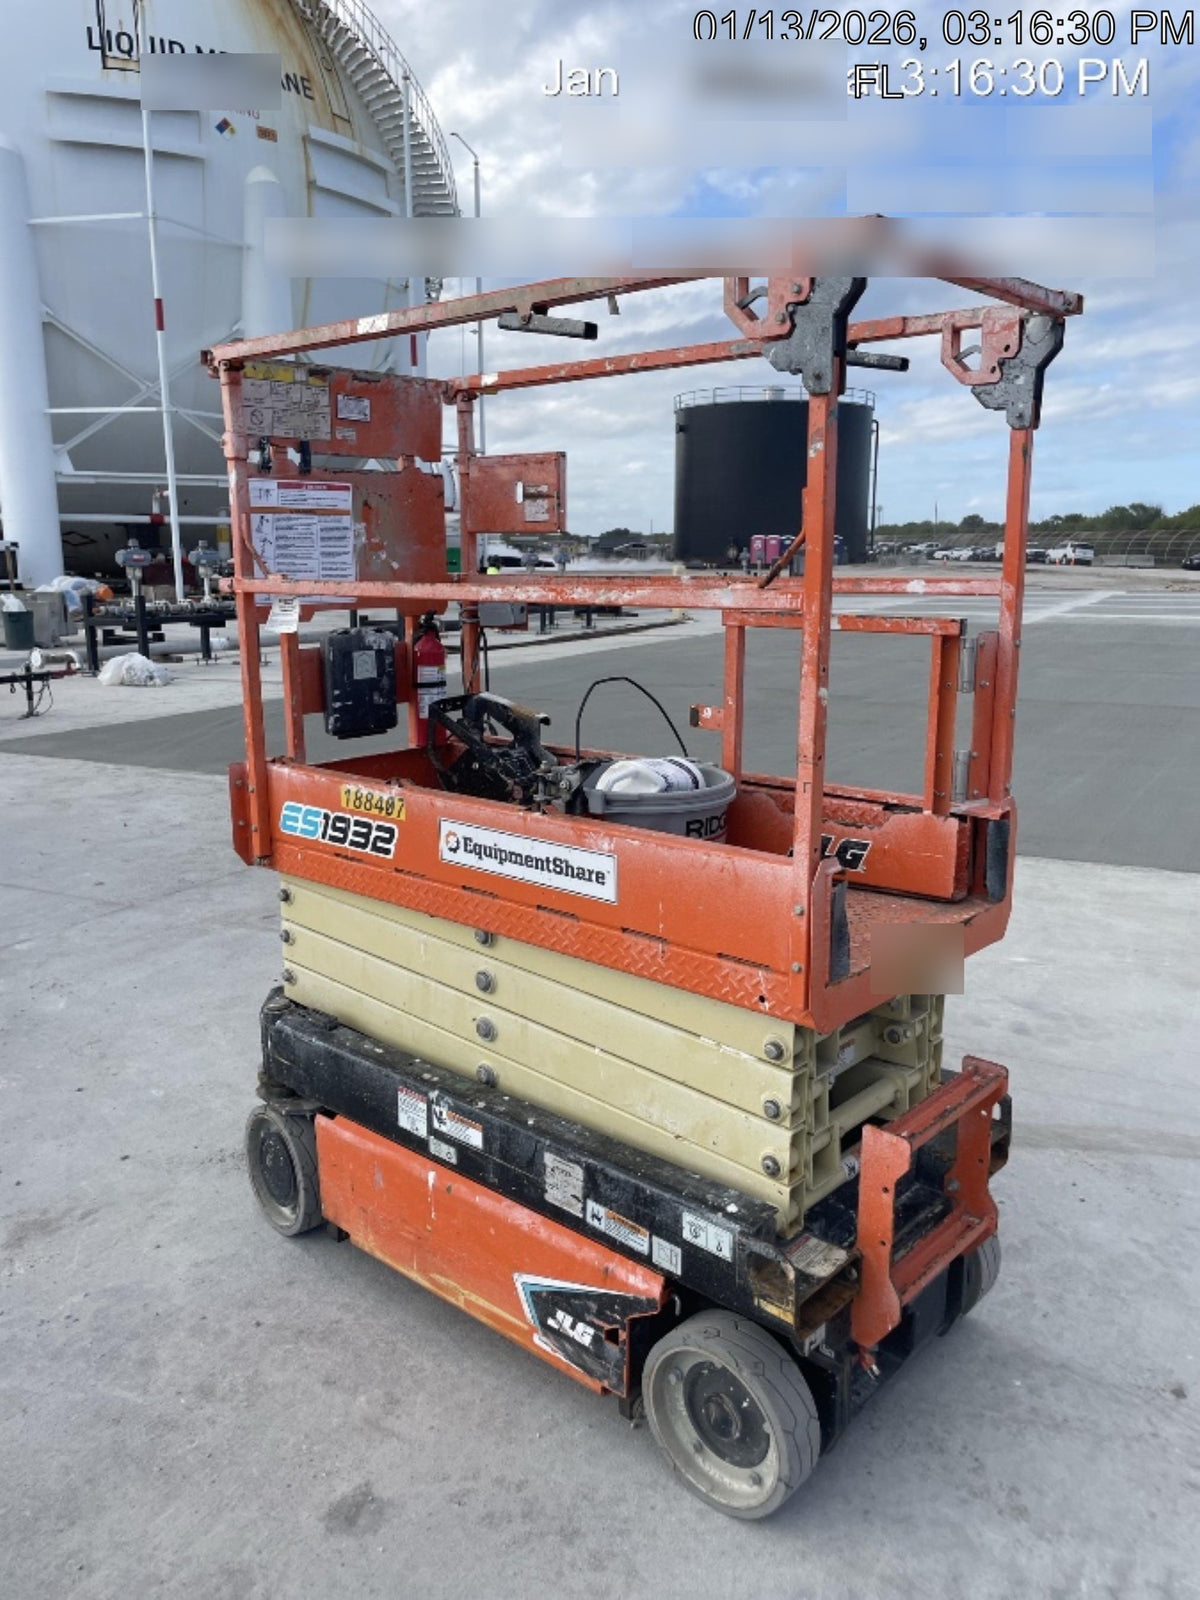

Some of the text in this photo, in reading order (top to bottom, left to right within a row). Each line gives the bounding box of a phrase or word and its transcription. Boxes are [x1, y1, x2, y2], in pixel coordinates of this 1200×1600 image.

[344, 788, 404, 818] 188407
[280, 802, 398, 858] ES1932
[463, 836, 606, 886] EquipmentShare
[547, 1308, 596, 1348] JLG
